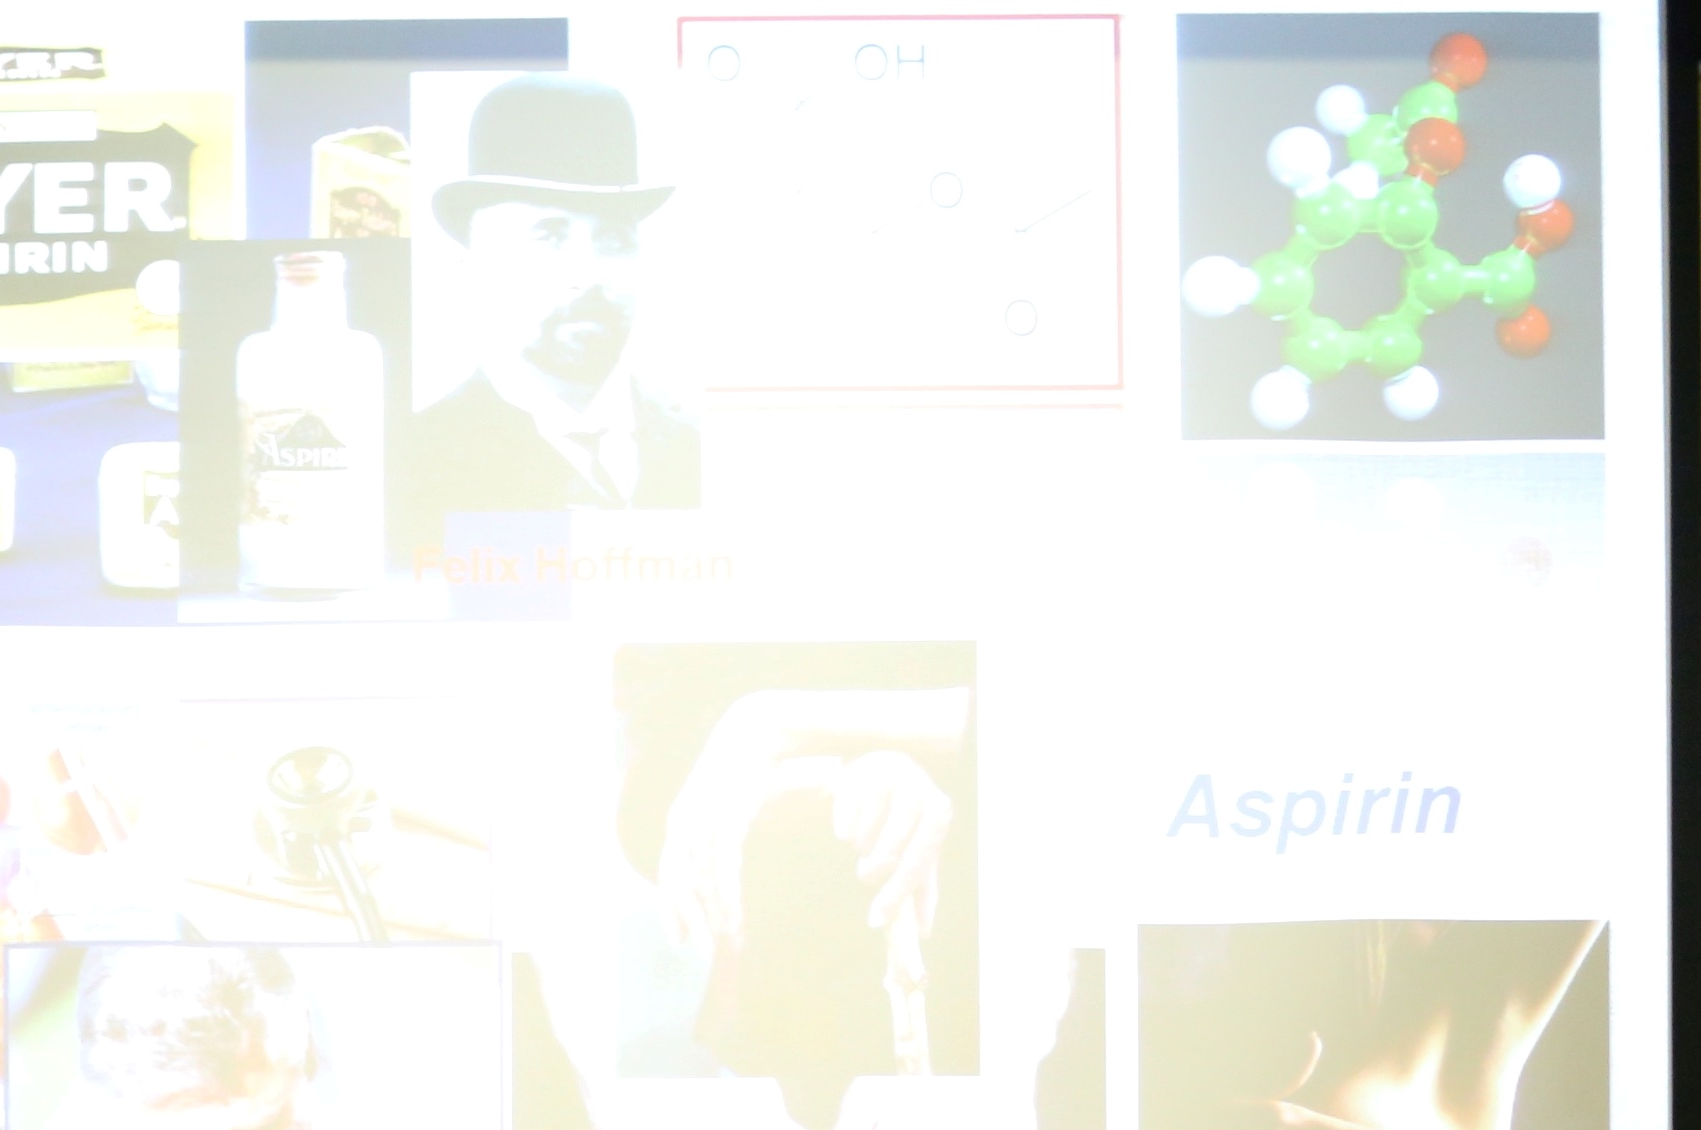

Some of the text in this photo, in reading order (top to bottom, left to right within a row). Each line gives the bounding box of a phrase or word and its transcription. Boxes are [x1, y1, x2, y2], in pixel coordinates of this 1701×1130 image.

[412, 545, 732, 583] Felix Hoffman
[1166, 771, 1461, 854] Aspirin
